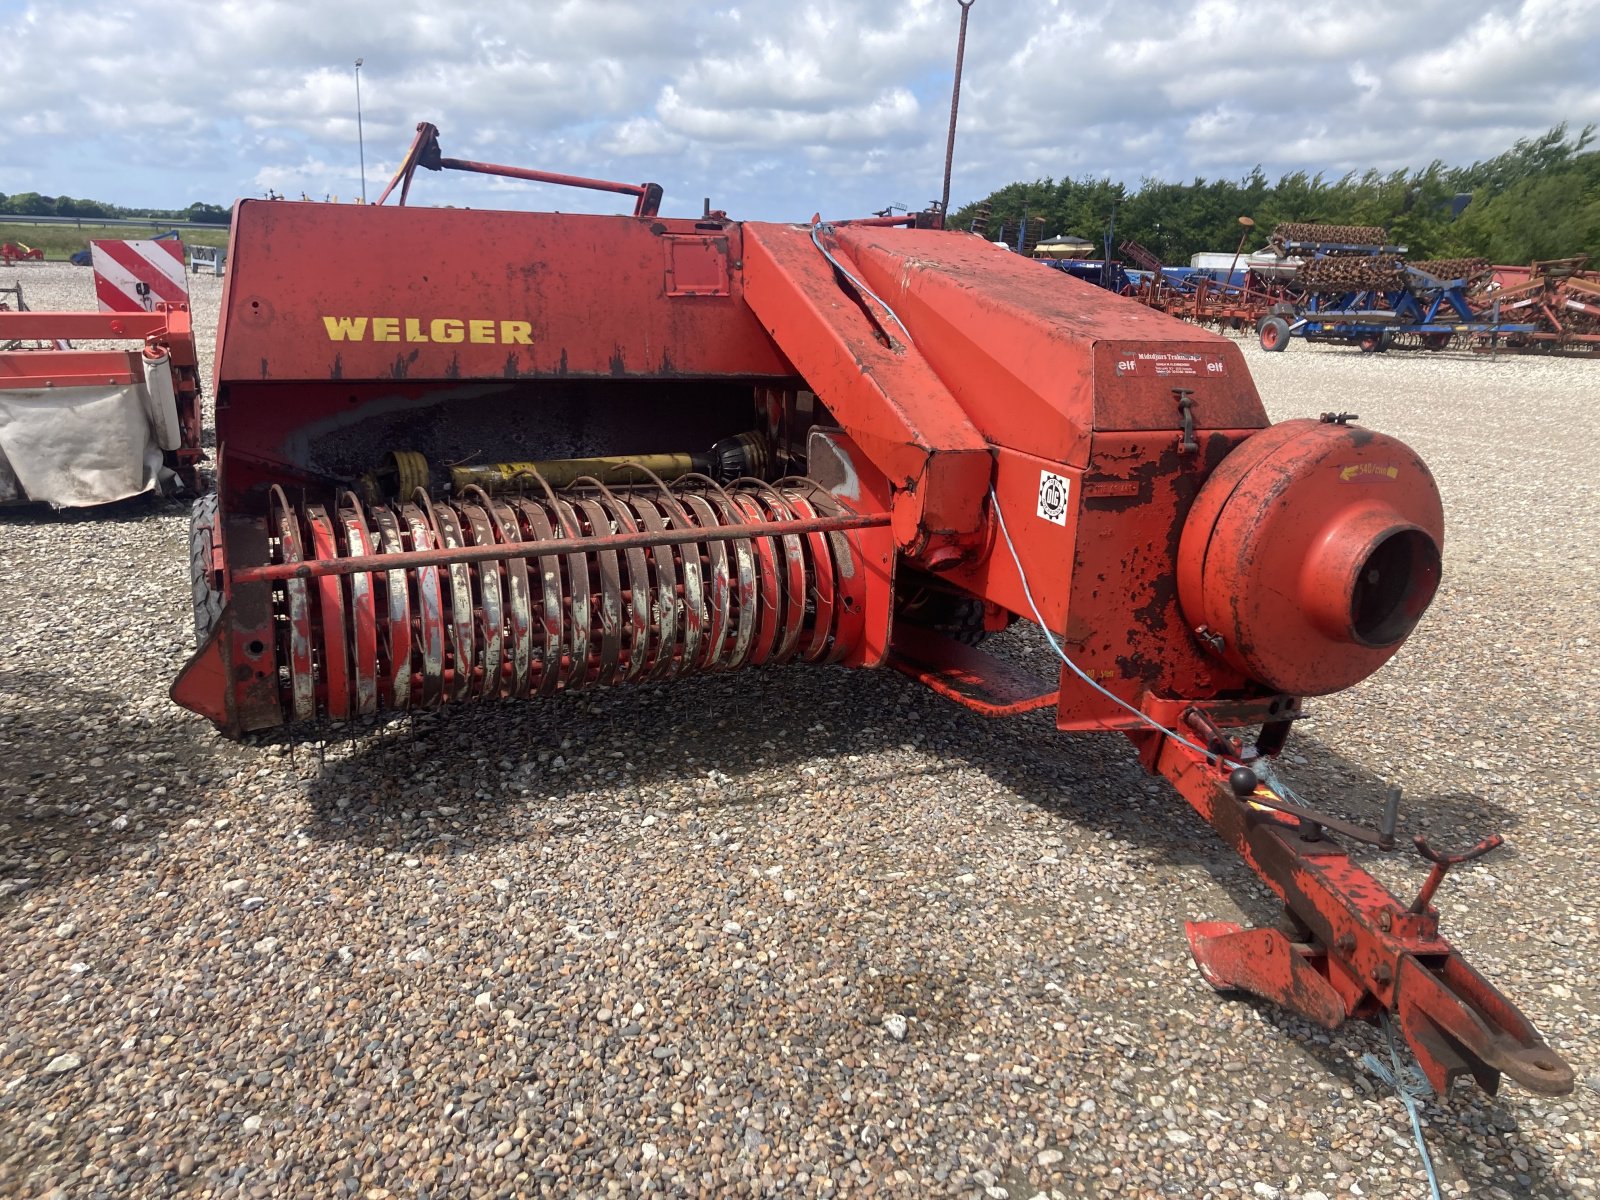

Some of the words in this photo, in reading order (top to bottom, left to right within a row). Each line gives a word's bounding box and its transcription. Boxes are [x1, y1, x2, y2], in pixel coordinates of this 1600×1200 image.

[322, 316, 534, 345] WELGER
[1118, 360, 1136, 371] elf
[1207, 361, 1224, 372] elf
[1359, 463, 1387, 476] 540/min
